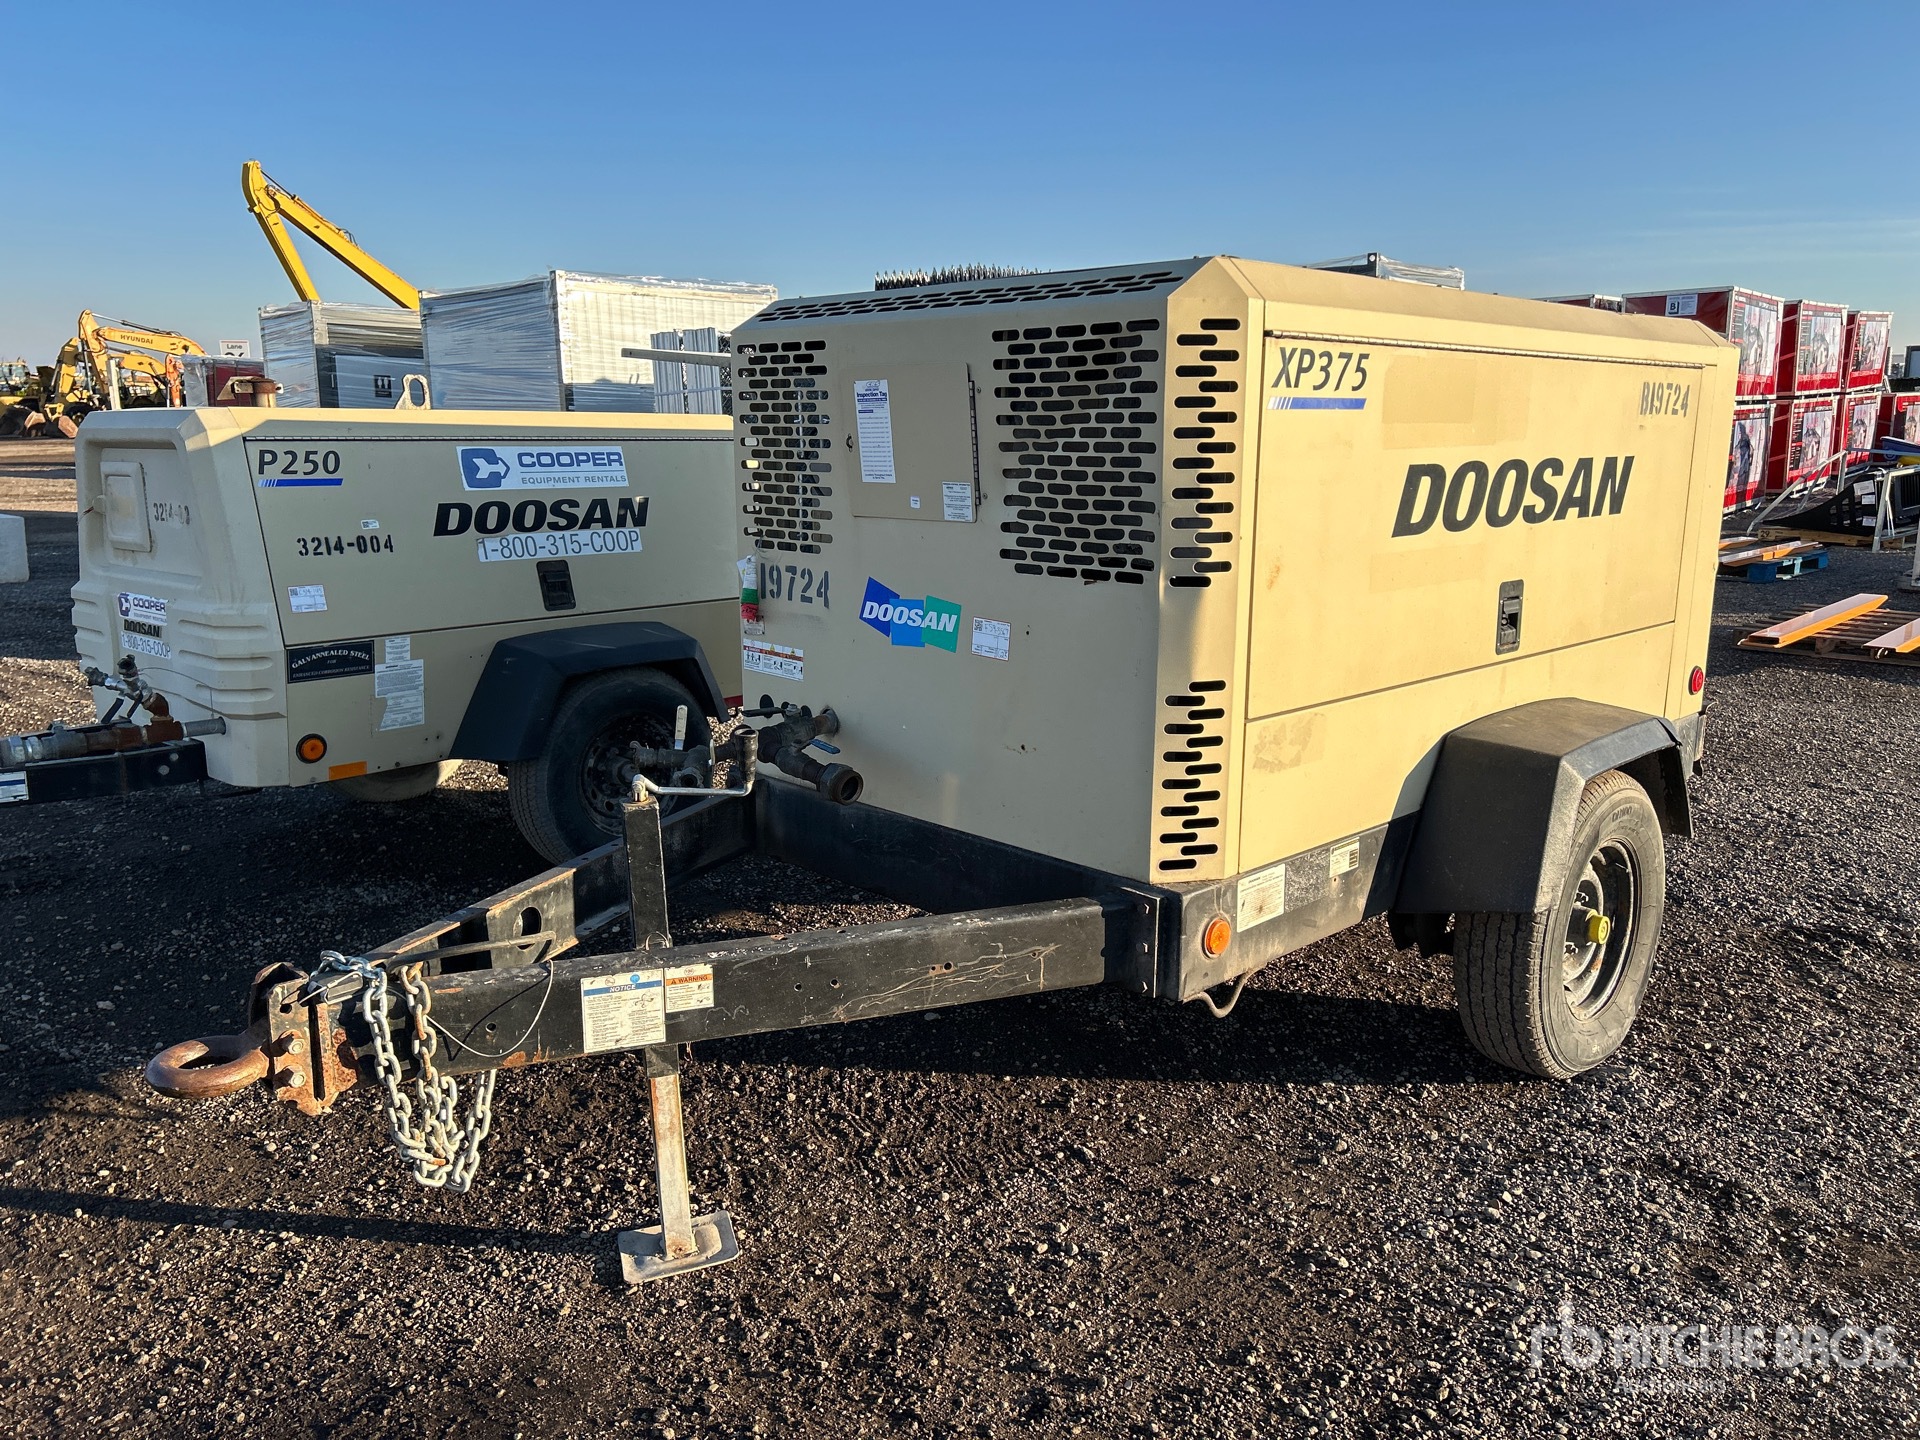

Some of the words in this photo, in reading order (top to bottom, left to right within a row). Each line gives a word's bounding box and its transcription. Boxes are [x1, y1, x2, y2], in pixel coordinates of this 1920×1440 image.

[120, 334, 154, 345] HYUNDAI
[1272, 347, 1370, 392] XP375
[1640, 381, 1690, 418] B19724
[258, 449, 341, 476] P250
[517, 451, 624, 468] COOPER
[521, 477, 580, 486] EQUIPMENT
[584, 474, 627, 483] RENTALS
[1391, 455, 1635, 539] DOOSAN
[433, 496, 650, 537] DOOSAN
[296, 534, 394, 557] 3214-004
[477, 530, 640, 561] 1-800-315-COOP
[133, 597, 166, 611] COOPER
[863, 601, 957, 633] DOOSAN
[124, 619, 160, 637] DOOSAN
[291, 649, 349, 669] GALVANNEALED
[350, 650, 370, 661] STEEL
[609, 984, 636, 993] NOTICE
[679, 975, 708, 984] WARNING
